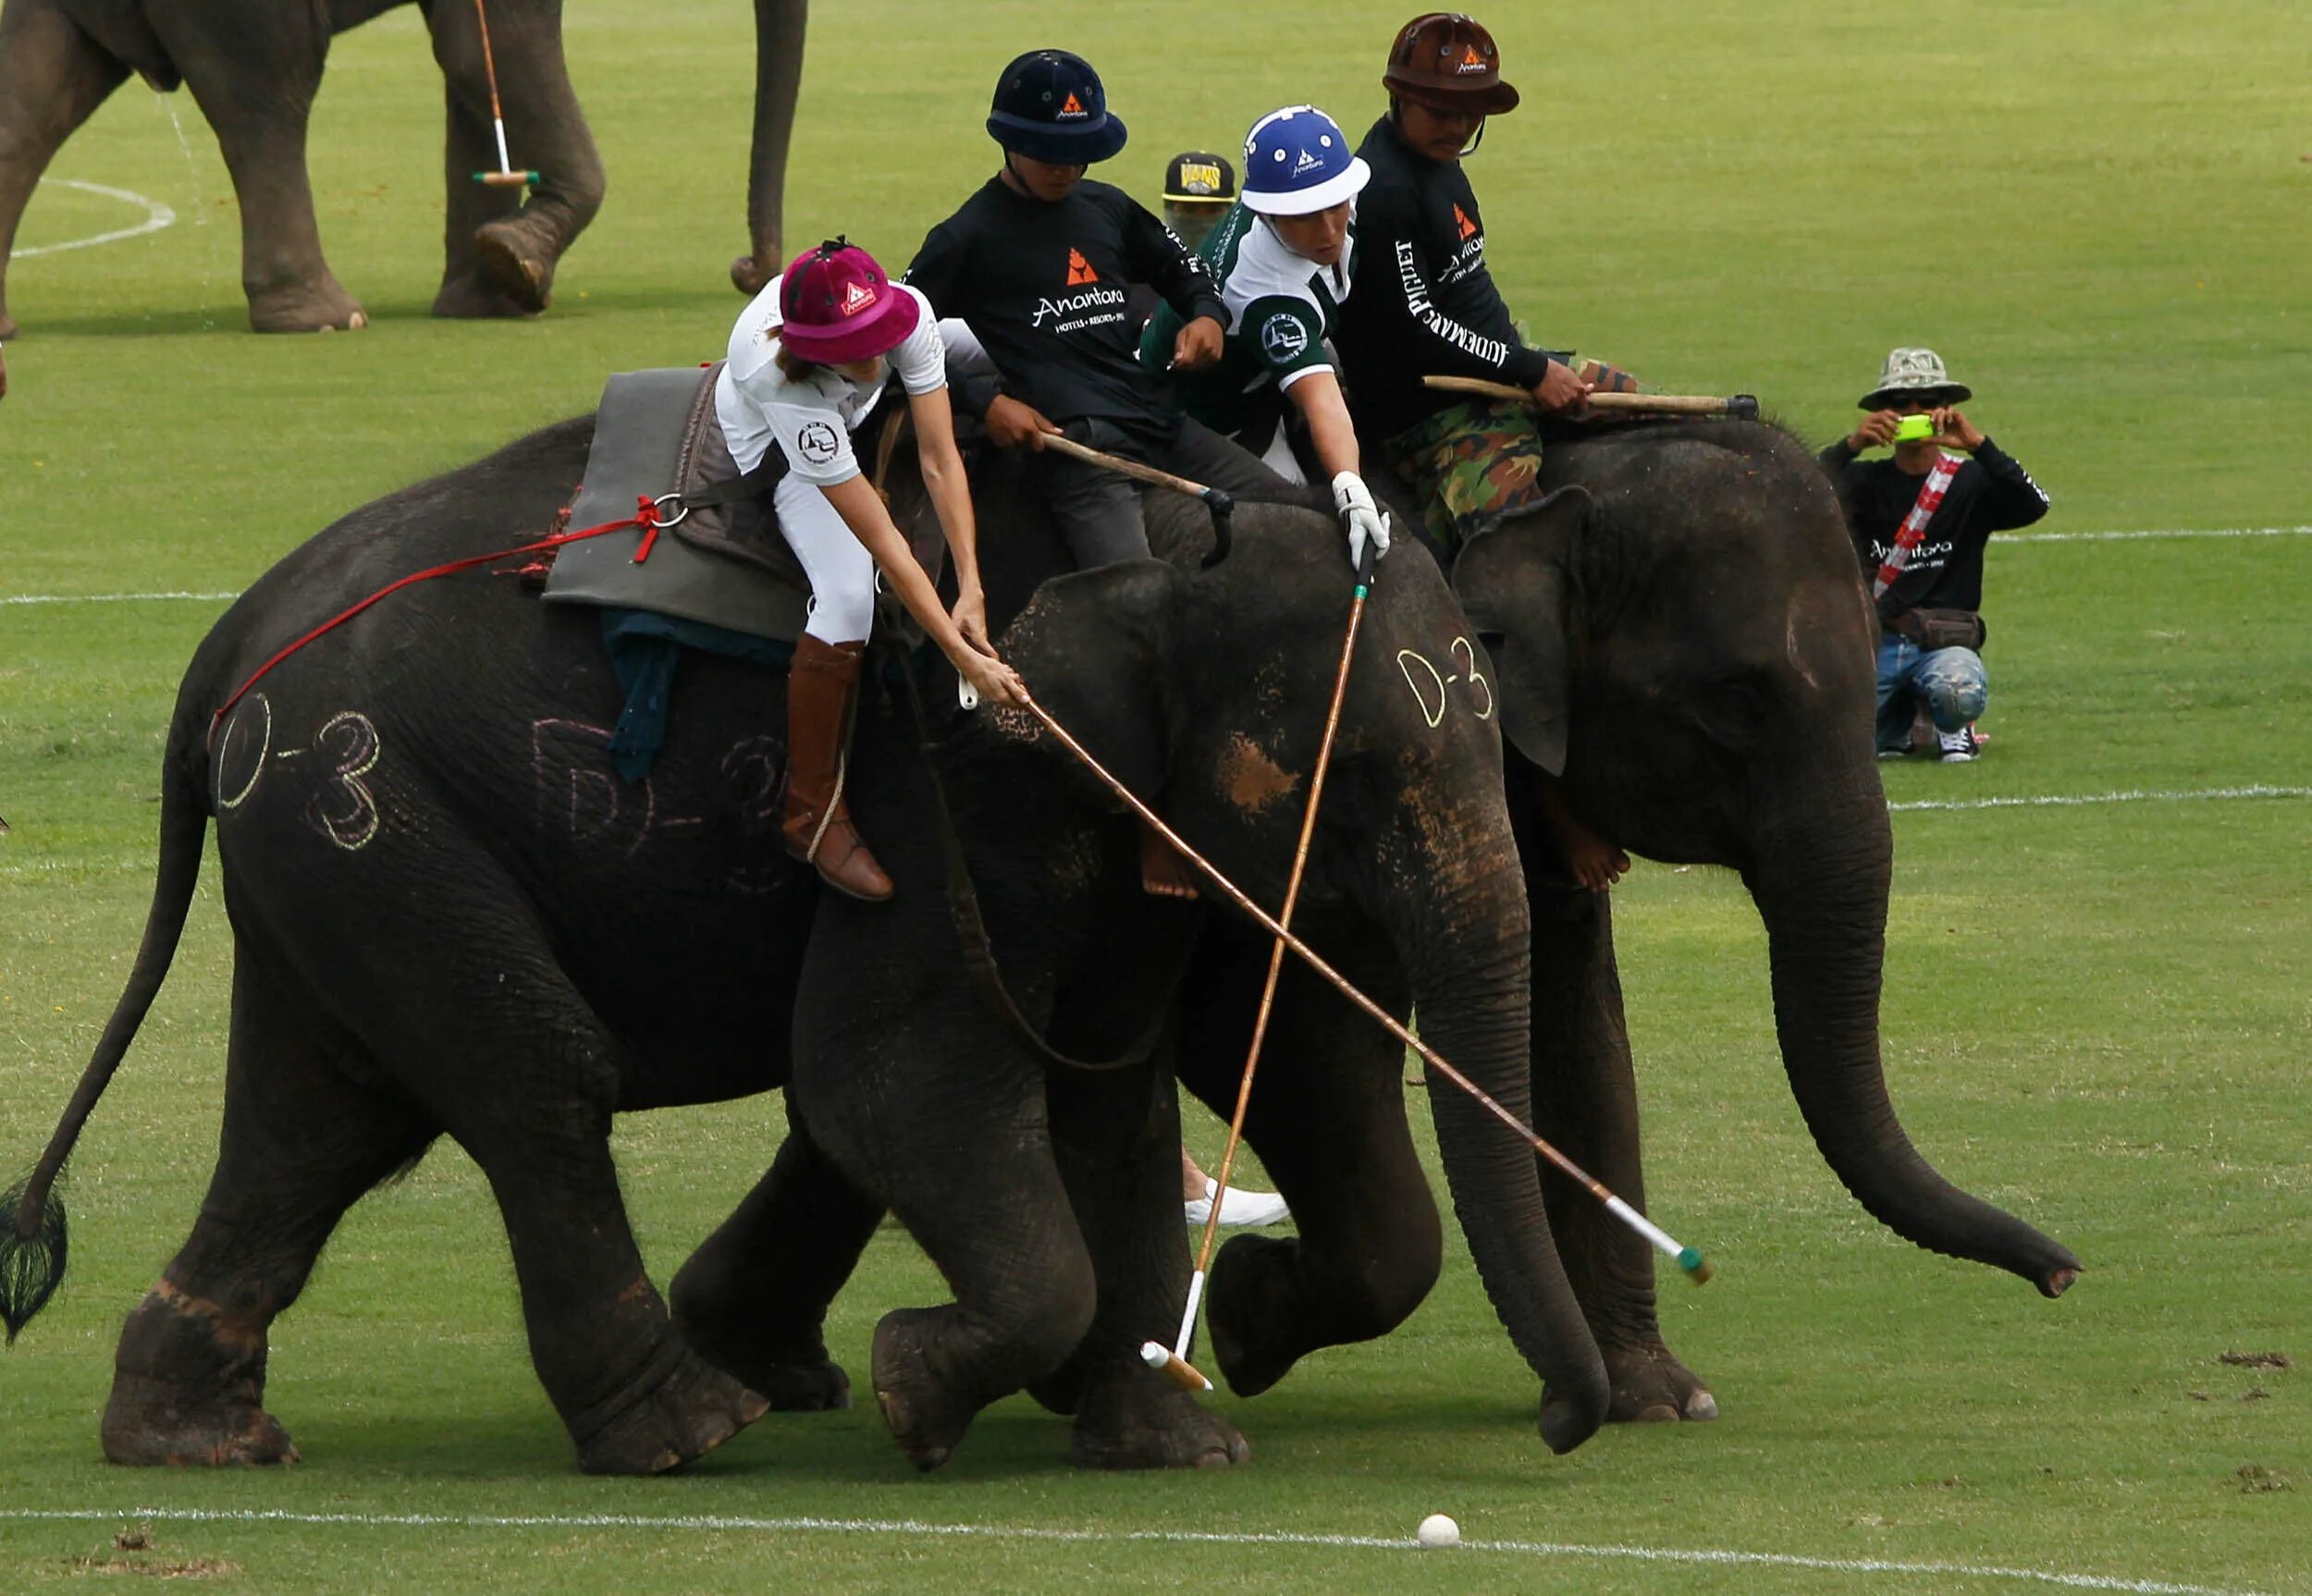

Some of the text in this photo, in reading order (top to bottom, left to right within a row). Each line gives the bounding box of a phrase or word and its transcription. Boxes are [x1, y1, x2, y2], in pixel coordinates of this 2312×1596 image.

[1031, 287, 1125, 327] Anantara
[1055, 318, 1085, 334] HOTELS
[1396, 635, 1493, 728] D-3
[215, 692, 381, 851] D-3
